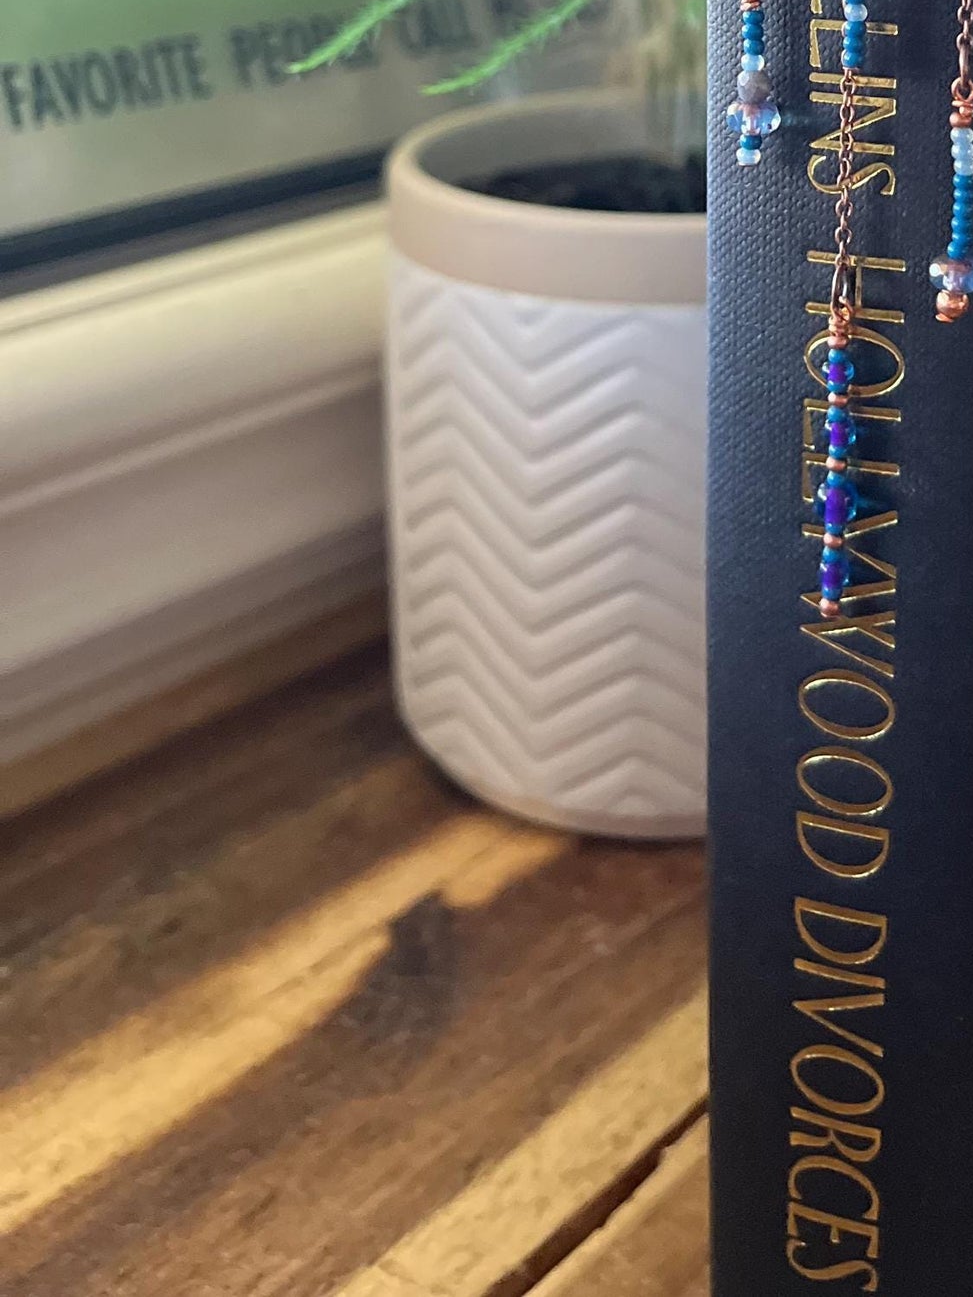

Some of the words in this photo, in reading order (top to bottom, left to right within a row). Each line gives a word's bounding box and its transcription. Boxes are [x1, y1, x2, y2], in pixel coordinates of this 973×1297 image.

[2, 32, 211, 132] FAVORITE
[796, 250, 907, 880] HOLLYWOOD
[786, 895, 888, 1292] DIVORCES
